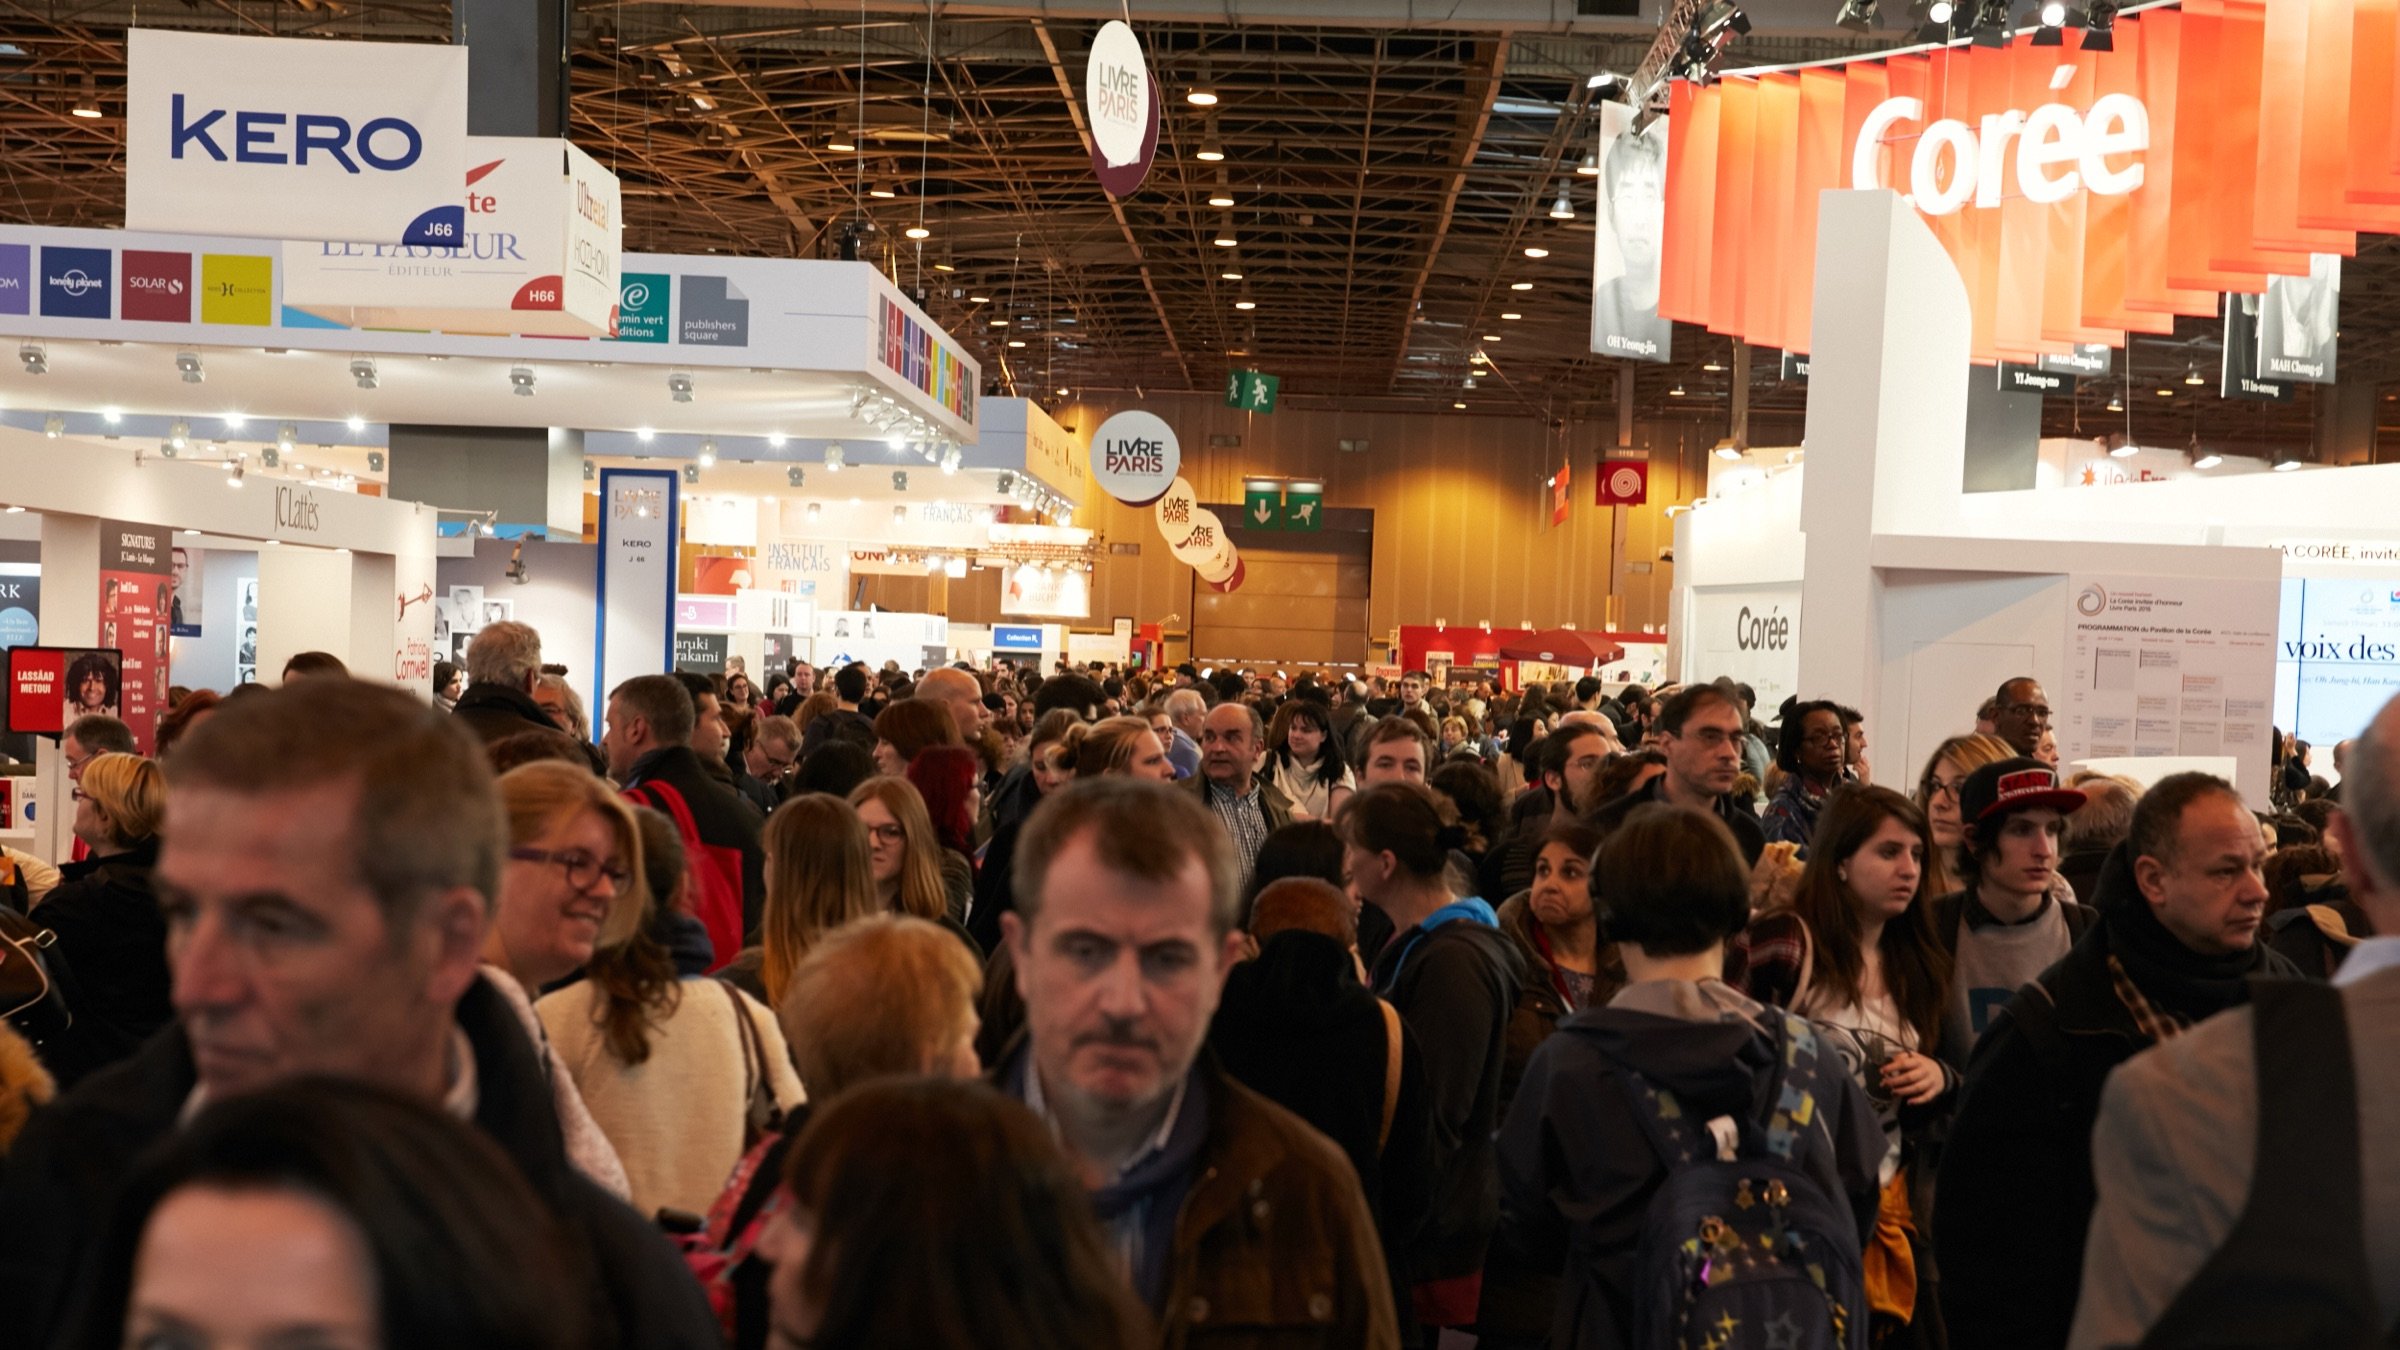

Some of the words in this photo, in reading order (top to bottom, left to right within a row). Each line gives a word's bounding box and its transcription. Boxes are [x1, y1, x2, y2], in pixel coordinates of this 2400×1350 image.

[1099, 62, 1138, 98] LIVRE
[1099, 89, 1138, 123] PARIS
[171, 93, 424, 174] KERO
[1852, 64, 2149, 215] Corée
[466, 192, 496, 213] te
[424, 222, 453, 236] J66
[388, 264, 453, 277] ÉDITEUR
[49, 276, 74, 289] lonely
[76, 278, 102, 289] planet
[130, 277, 165, 288] SOLAR
[529, 290, 555, 303] H66
[643, 315, 663, 325] vert
[684, 320, 736, 331] publishers
[620, 326, 654, 337] ditions
[684, 331, 719, 342] square
[1607, 334, 1620, 348] OH
[2270, 358, 2291, 373] MAH
[2014, 371, 2024, 384] YI
[1106, 437, 1163, 457] LIVRE
[1106, 455, 1163, 474] PARIS
[288, 488, 319, 532] Lattès
[1163, 496, 1189, 511] LIVRE
[614, 504, 660, 520] PAS
[1163, 509, 1189, 524] PARIS
[1191, 525, 1213, 537] VRE
[121, 533, 155, 550] SIGNATURES
[622, 539, 652, 548] KERO
[1186, 536, 1213, 548] ARIS
[768, 543, 824, 559] INSTITUT
[2294, 543, 2355, 560] CORÉE,
[768, 556, 831, 573] FRANÇAIS
[1738, 605, 1788, 651] Corée
[2078, 623, 2139, 633] PROGRAMMATION
[676, 636, 708, 650] aruki
[2285, 634, 2341, 659] voix
[2349, 634, 2395, 661] des
[676, 648, 719, 663] rakami
[21, 683, 51, 694] METOUI
